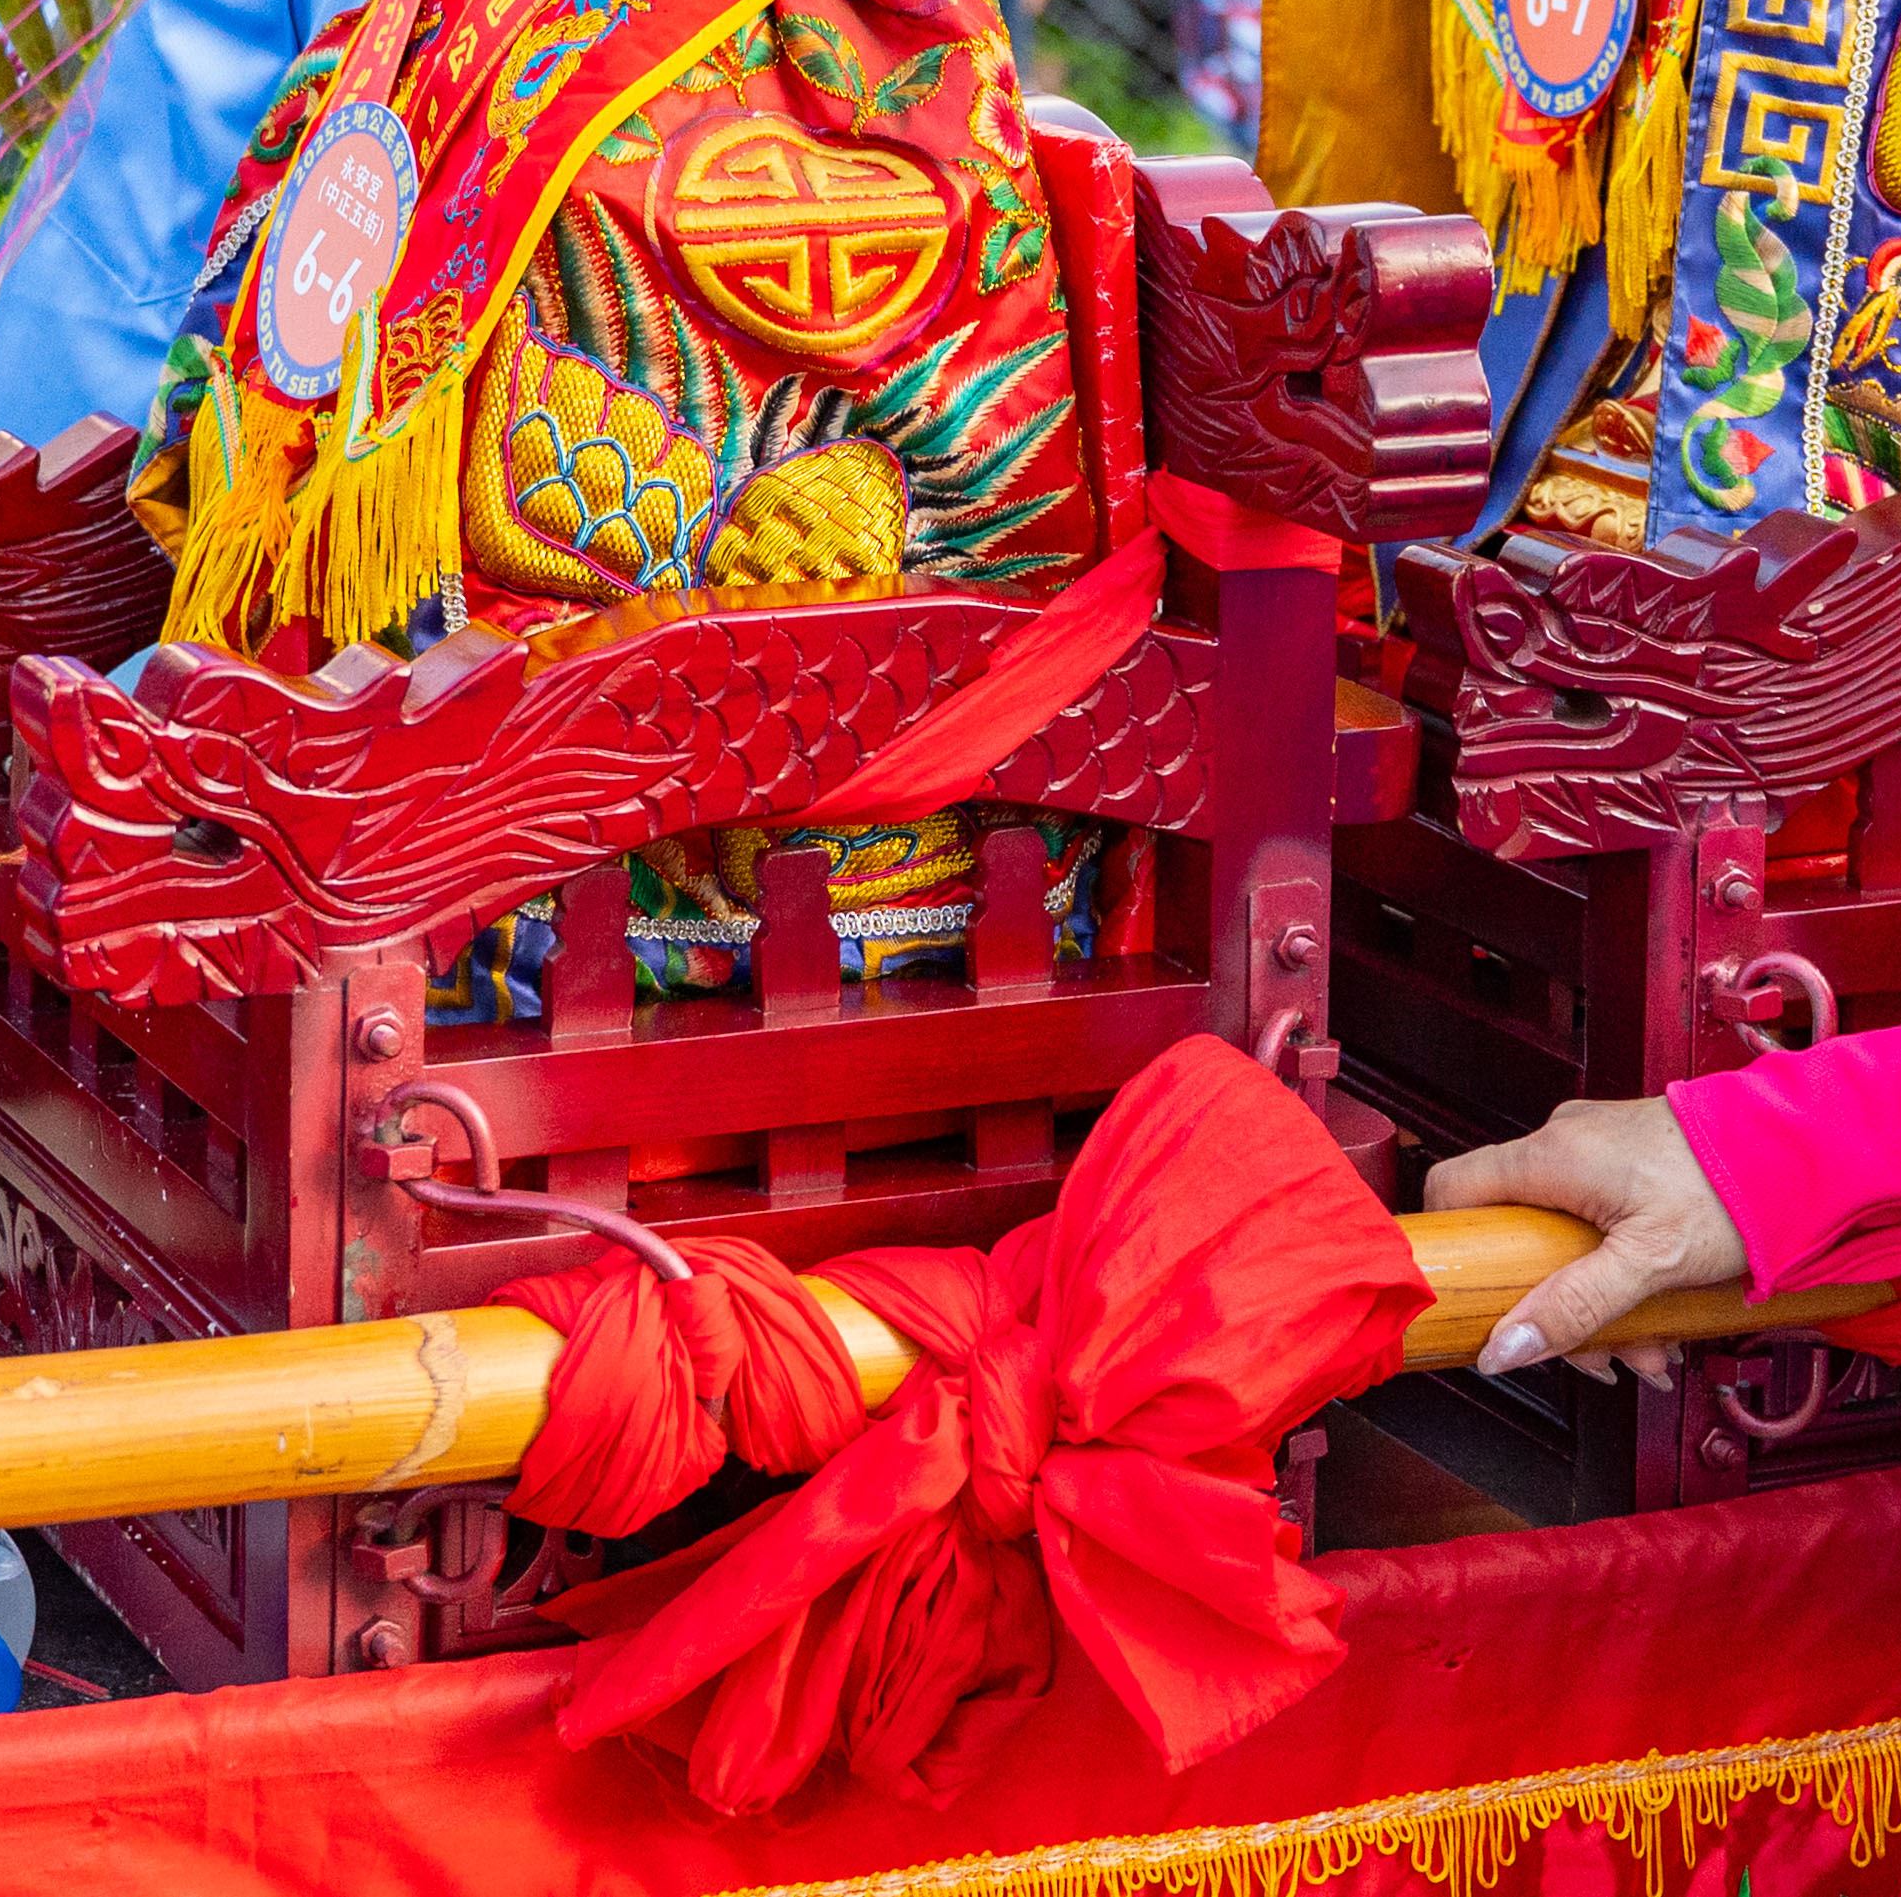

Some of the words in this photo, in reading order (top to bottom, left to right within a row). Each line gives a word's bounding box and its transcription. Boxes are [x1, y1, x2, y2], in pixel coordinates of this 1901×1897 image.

[1497, 12, 1529, 90] GOOD
[1531, 83, 1552, 111] TU
[1554, 85, 1585, 114] SEE
[1586, 39, 1619, 93] YOU
[317, 175, 385, 247] (中正五街)
[340, 154, 384, 204] 永安宮
[293, 228, 362, 325] 6-6
[259, 264, 275, 353] GOOD
[269, 350, 289, 385] TU
[287, 374, 321, 397] SEE
